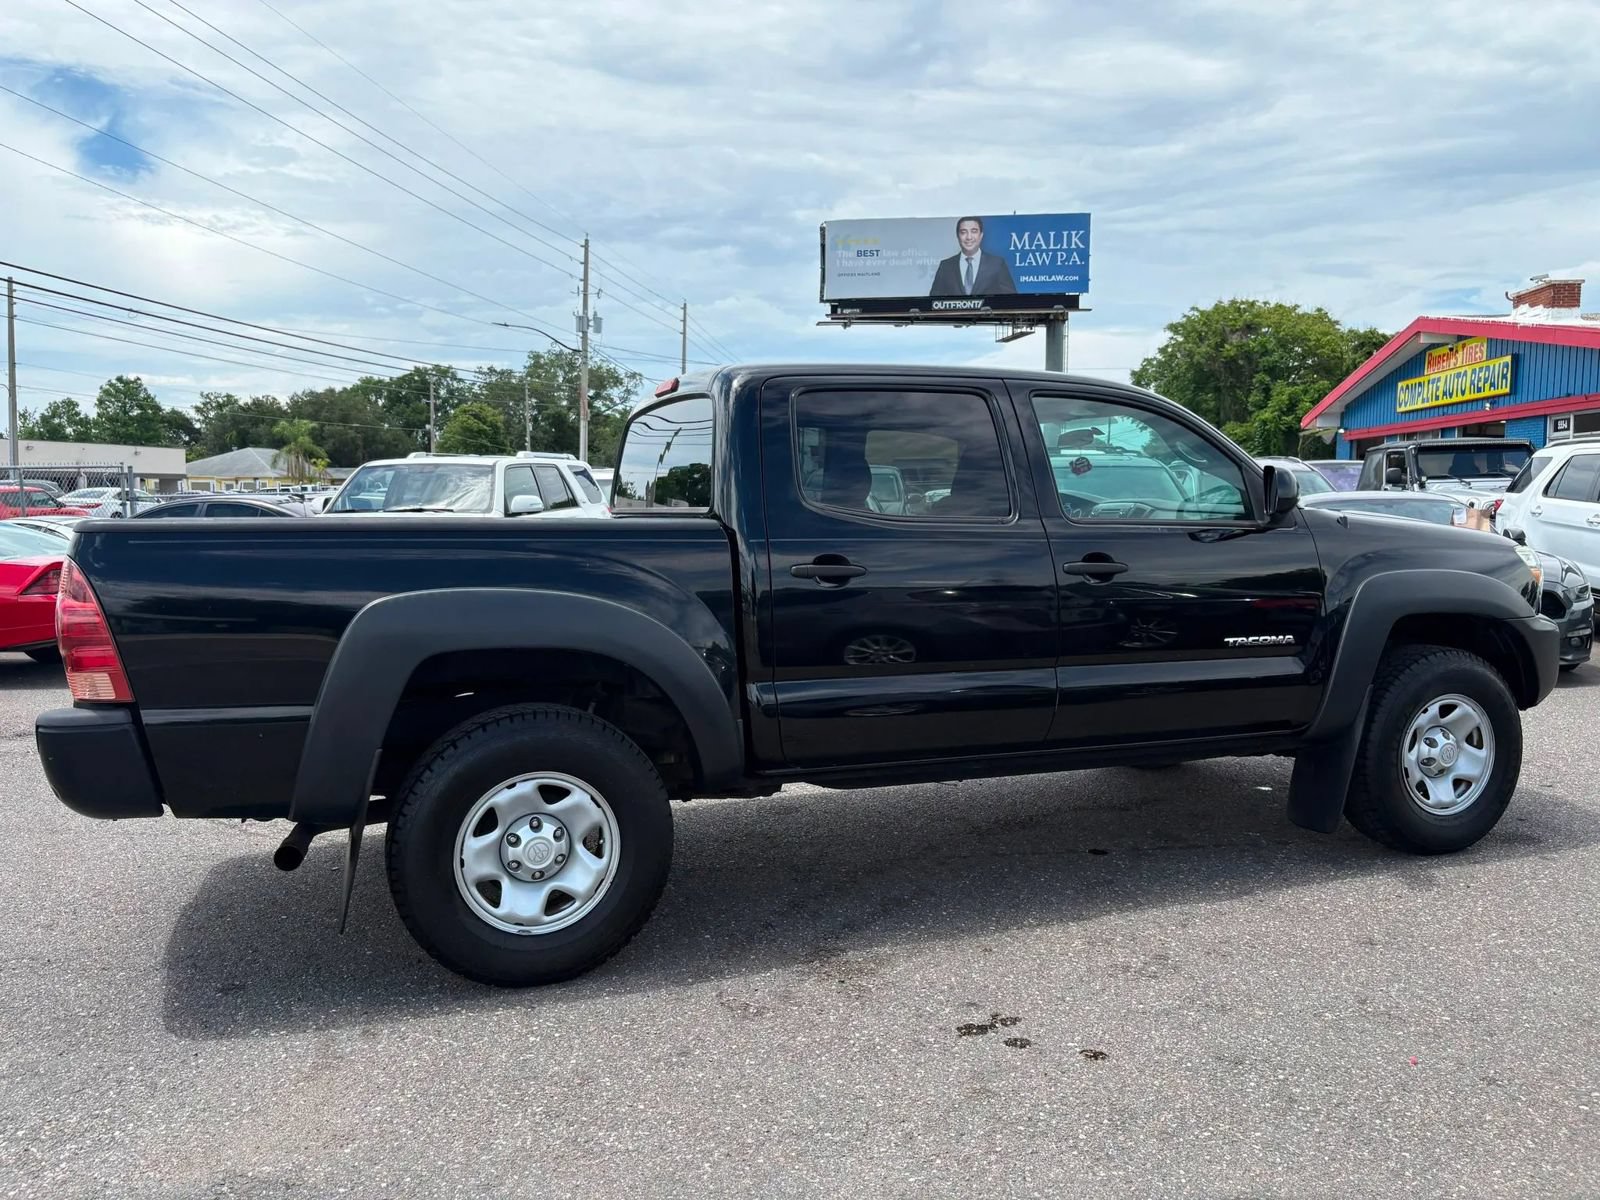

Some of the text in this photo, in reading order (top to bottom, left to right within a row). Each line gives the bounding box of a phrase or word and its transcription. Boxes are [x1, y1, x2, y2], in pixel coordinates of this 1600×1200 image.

[1009, 230, 1085, 250] MALIK
[856, 249, 880, 257] BEST
[1015, 251, 1085, 266] LAW P.A.
[1462, 342, 1485, 364] TIRES
[1398, 360, 1510, 408] COMPLETE AUTO REPAIR
[1224, 635, 1295, 647] TACOMA
